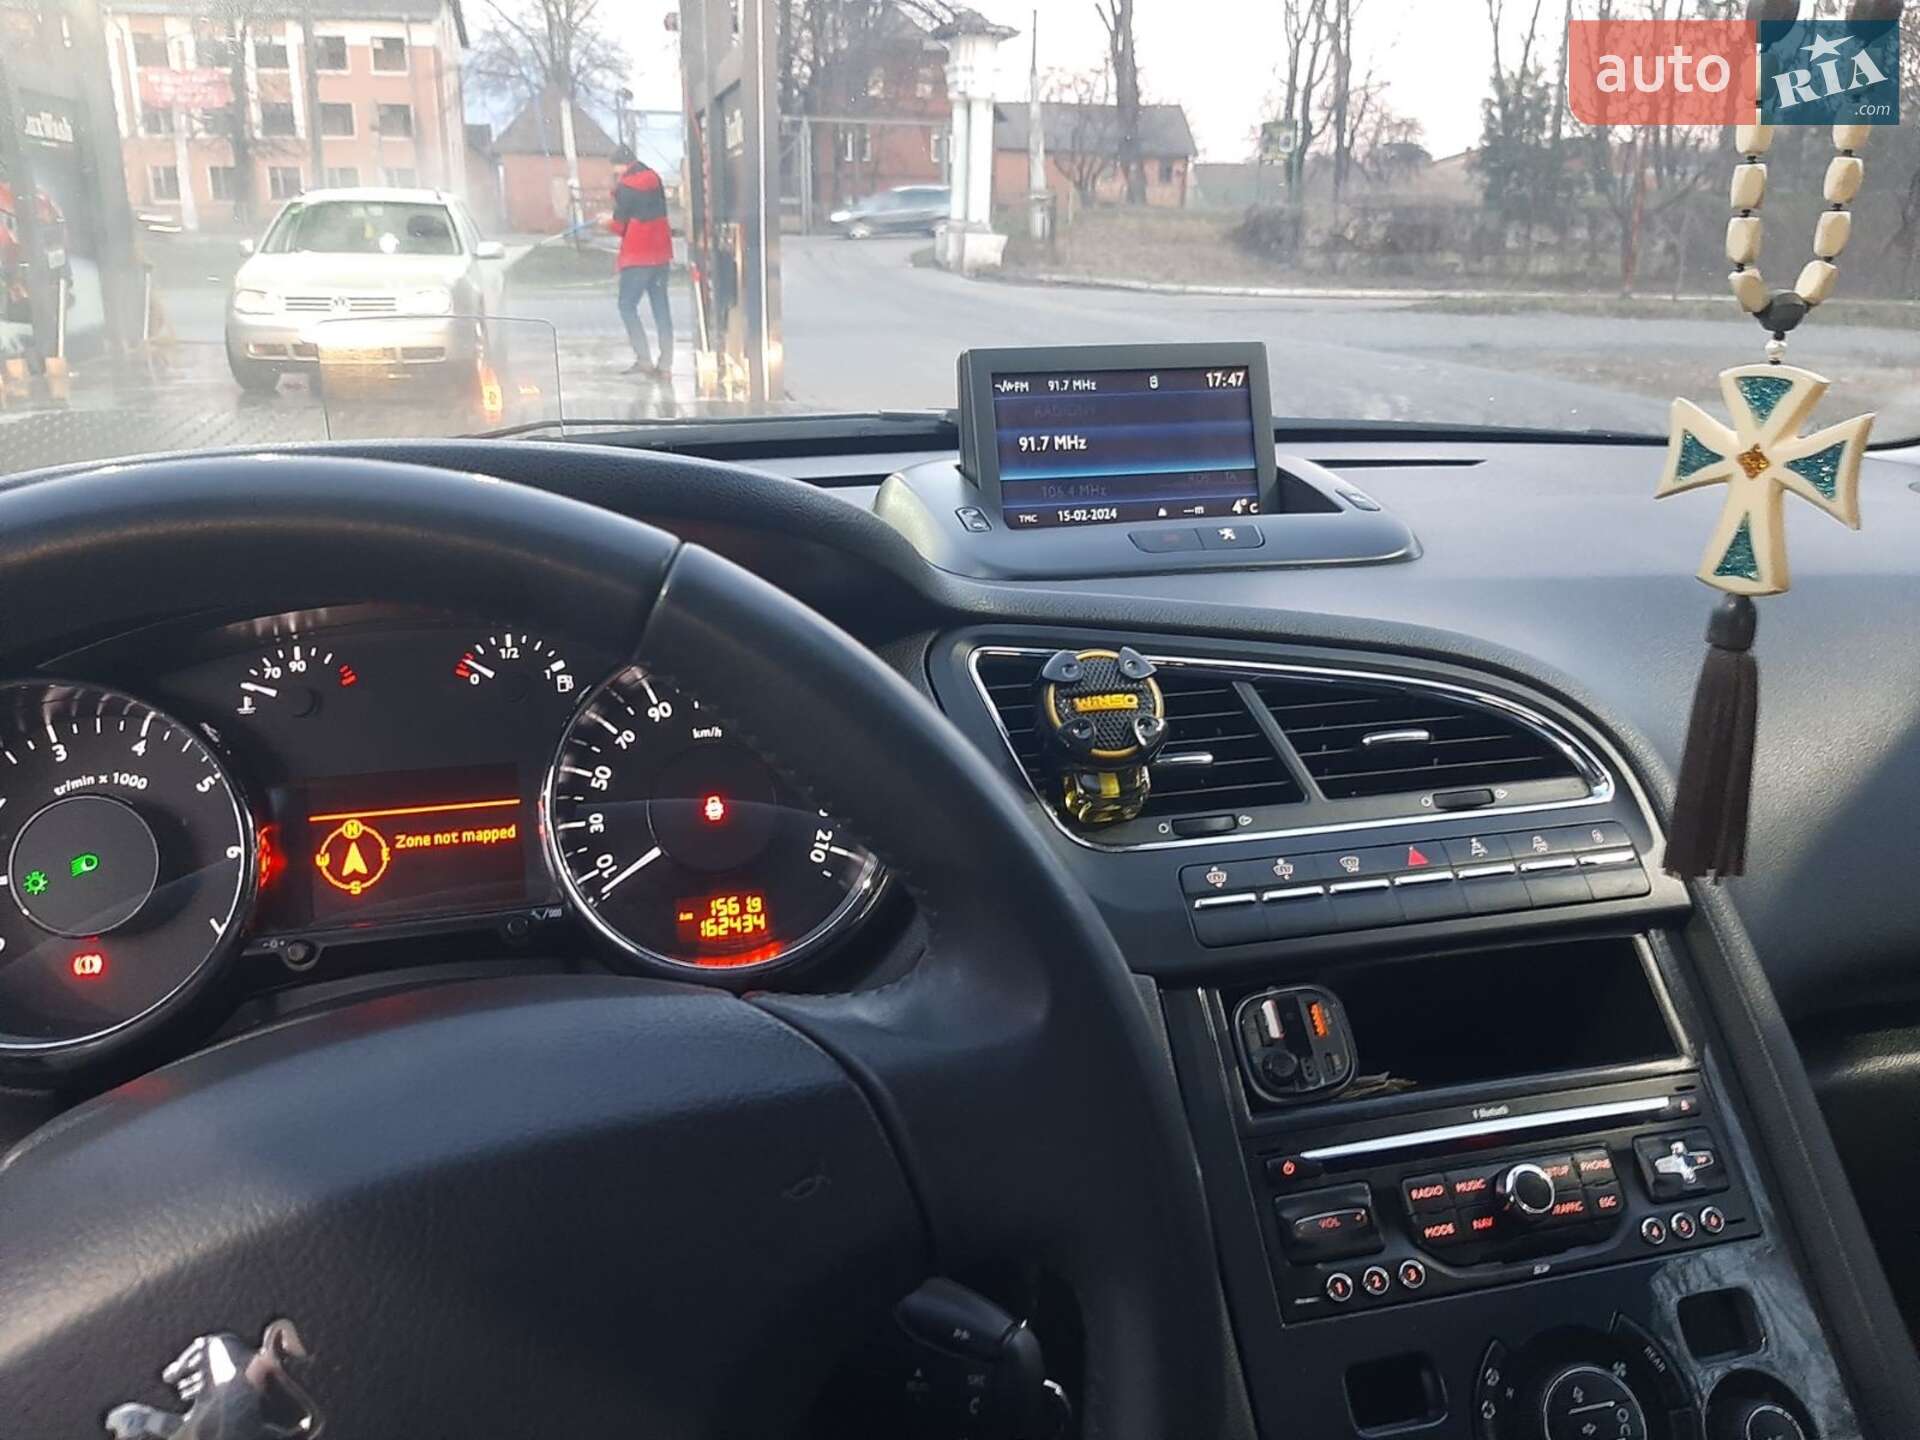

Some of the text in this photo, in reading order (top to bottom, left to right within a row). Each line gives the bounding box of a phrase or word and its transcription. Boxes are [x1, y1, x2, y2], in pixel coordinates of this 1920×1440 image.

[1047, 380, 1069, 391] 91.7
[1072, 379, 1097, 391] MHz
[1206, 371, 1246, 388] 17:47
[1018, 434, 1087, 452] 91.7 MHz
[1018, 514, 1038, 523] TMC
[1057, 508, 1118, 522] 15-02-2024
[500, 648, 519, 660] 1/2
[263, 667, 282, 679] 70
[289, 660, 307, 673] 90
[1074, 693, 1139, 712] WINSO
[648, 702, 673, 721] 90
[615, 729, 636, 750] 70
[693, 727, 722, 739] km/h
[51, 744, 68, 762] 3
[131, 740, 147, 757] 4
[53, 775, 96, 796] tr/min
[113, 771, 148, 789] 1000
[196, 775, 216, 792] 5
[590, 765, 612, 791] 50
[589, 813, 604, 834] 30
[395, 824, 516, 849] Zone not mapped
[810, 829, 833, 864] 210
[596, 853, 618, 878] 10
[700, 913, 765, 937] 162434
[1411, 1185, 1444, 1200] RADIO
[1455, 1178, 1487, 1193] MUSIC
[1423, 1222, 1455, 1239] MODE
[1371, 1275, 1381, 1288] 2
[1407, 1268, 1418, 1280] 3
[1335, 1281, 1344, 1294] 1
[1642, 1344, 1667, 1374] REAR
